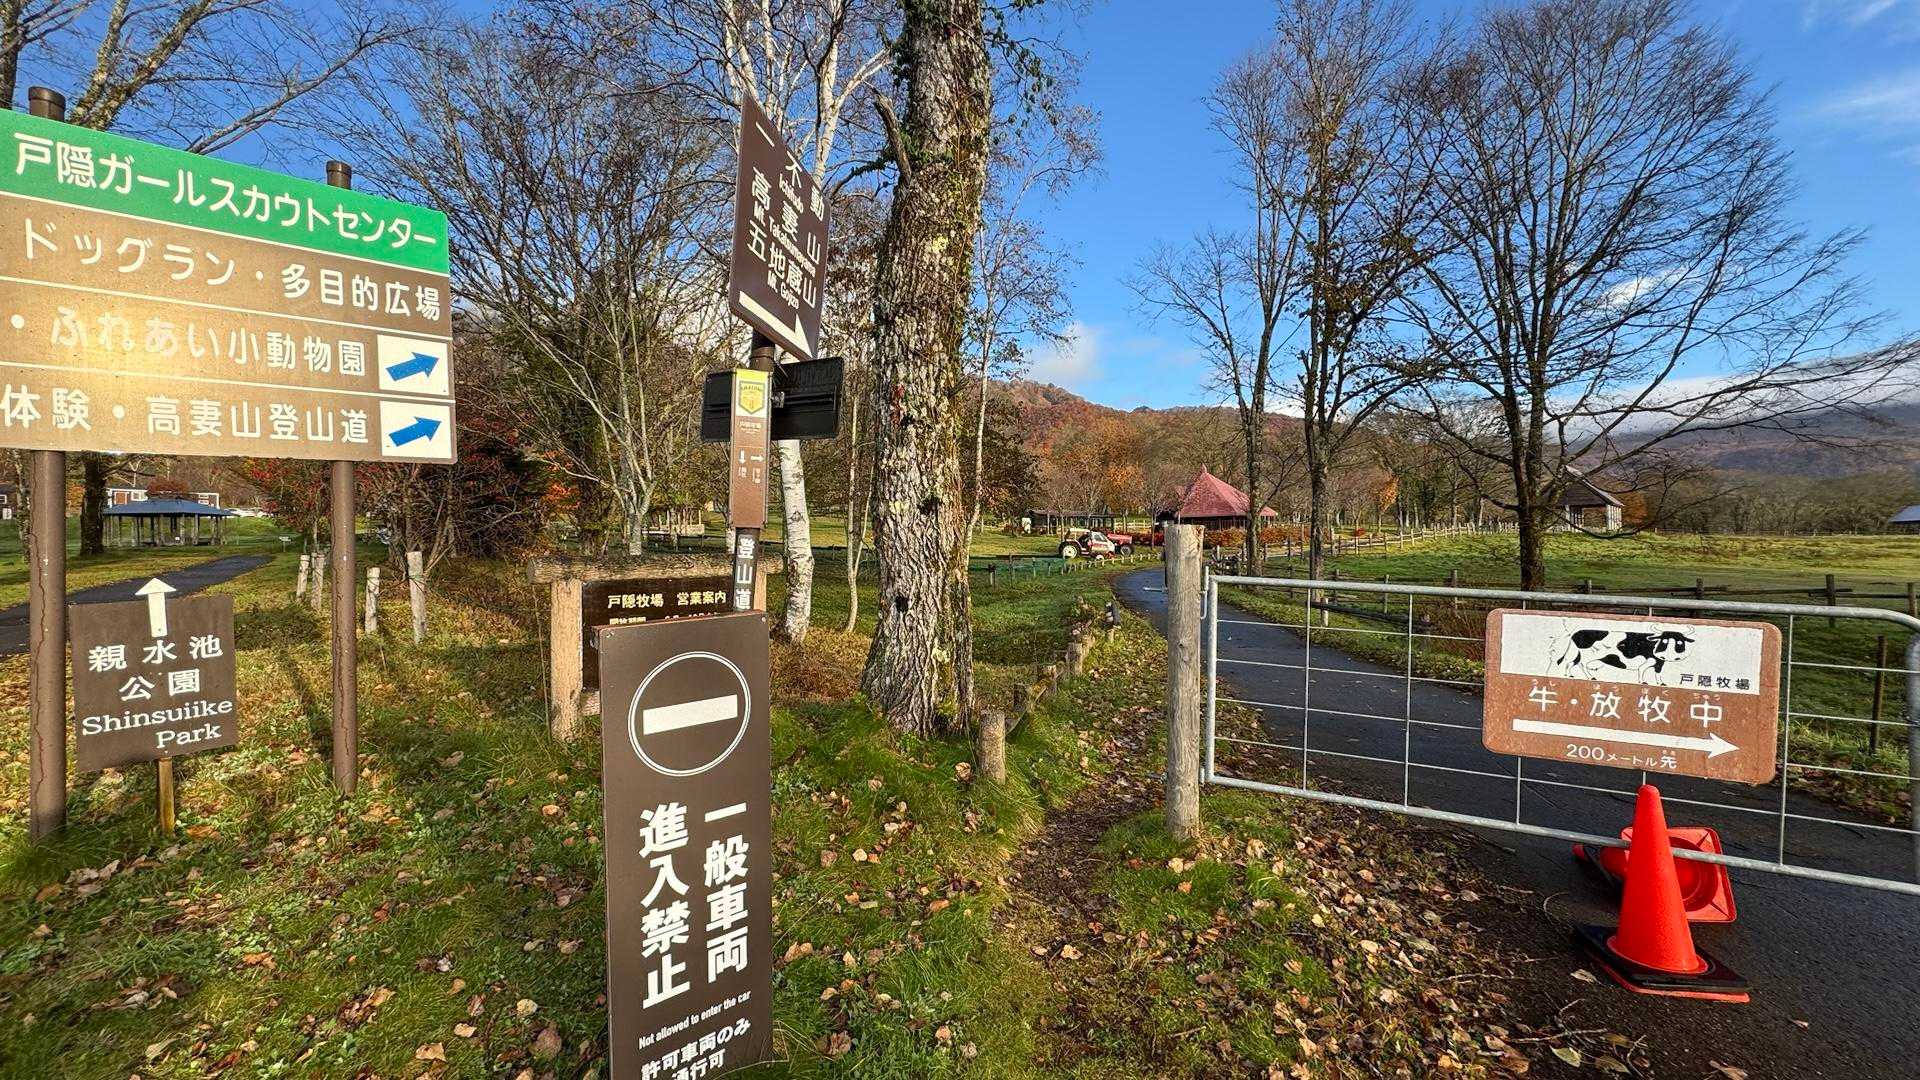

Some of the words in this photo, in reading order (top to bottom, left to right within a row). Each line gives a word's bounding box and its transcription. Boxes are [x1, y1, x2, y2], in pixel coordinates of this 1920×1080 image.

[14, 132, 437, 248] 戸隠ガールスカウトセンター
[751, 166, 821, 265] 高妻山
[23, 217, 441, 322] ドッグラン・多目的広場
[747, 219, 817, 309] 五地蔵山
[0, 383, 370, 445] 体験・高妻山登山道
[607, 594, 664, 609] 戸隠牧場
[676, 590, 727, 606] 営業案内
[735, 537, 754, 610] 登山道
[88, 634, 224, 673] 親水池
[1679, 673, 1751, 691] 戸隠牧場
[118, 668, 201, 702] 公園
[1528, 685, 1723, 728] 牛・放牧中
[82, 699, 234, 736] Shinsuiike
[156, 723, 223, 749] Park
[638, 802, 691, 1009] 進入禁止
[703, 802, 750, 983] 一般車両
[639, 1033, 656, 1050] Not
[656, 1016, 690, 1041] allowed
[691, 1013, 700, 1025] to
[701, 1003, 723, 1020] enter
[723, 997, 737, 1010] the
[737, 990, 751, 1003] car
[641, 1018, 751, 1080] 許可車両のみ
